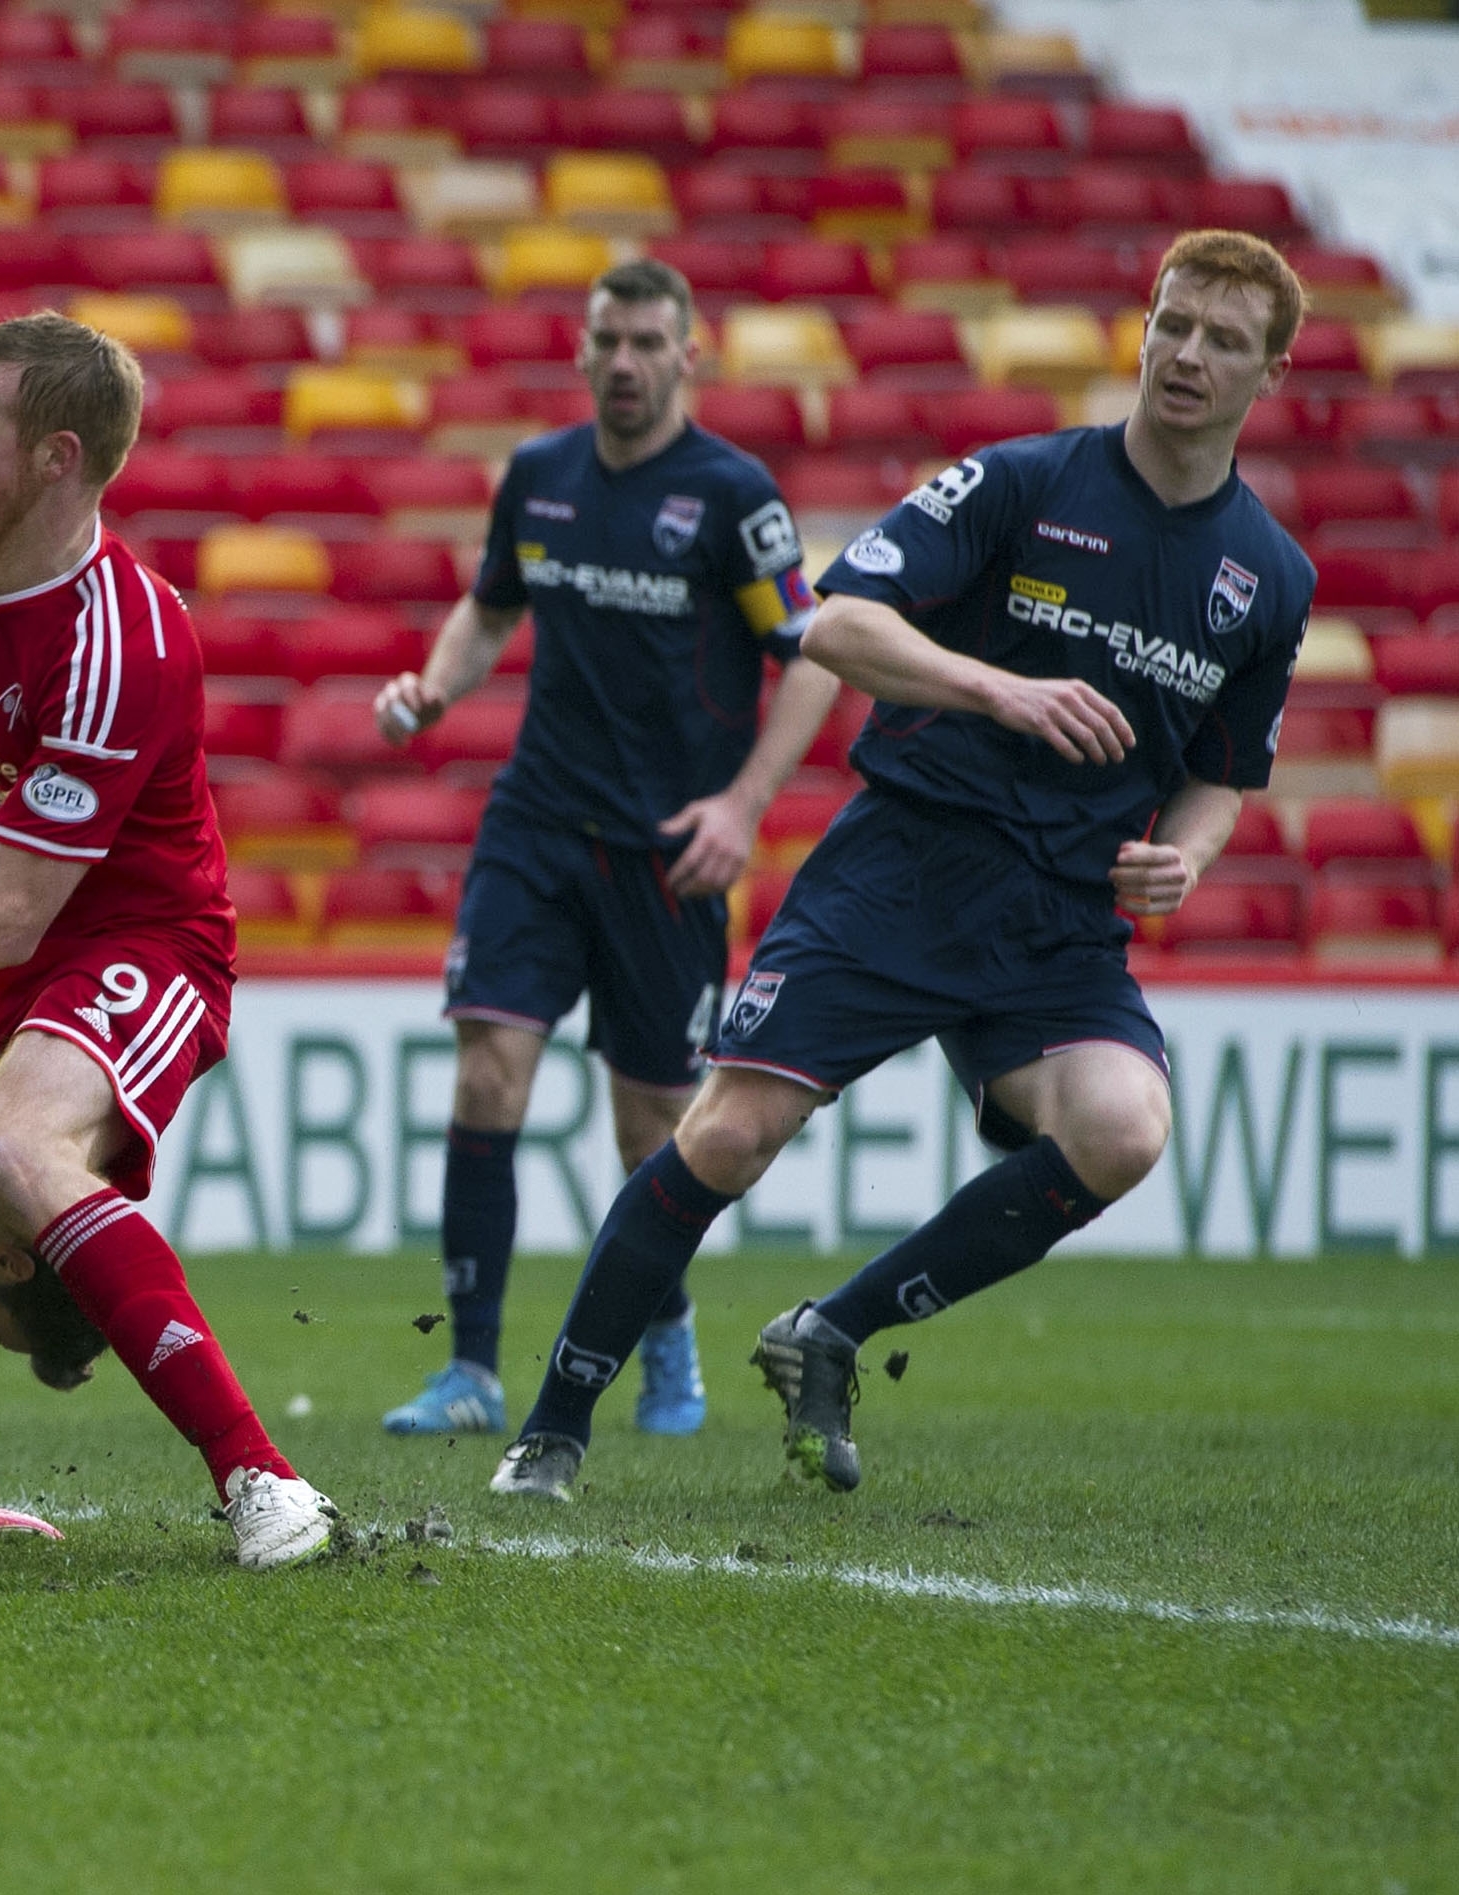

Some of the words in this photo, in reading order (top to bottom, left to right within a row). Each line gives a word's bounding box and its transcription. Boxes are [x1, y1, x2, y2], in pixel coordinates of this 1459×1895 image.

[1037, 522, 1108, 552] carbrini
[1014, 579, 1062, 600] STANLEY
[1007, 594, 1226, 690] CRC-EVANS
[41, 783, 86, 810] SPFL
[94, 962, 148, 1014] 9
[74, 1007, 112, 1043] adidas
[147, 1332, 204, 1371] adidas
